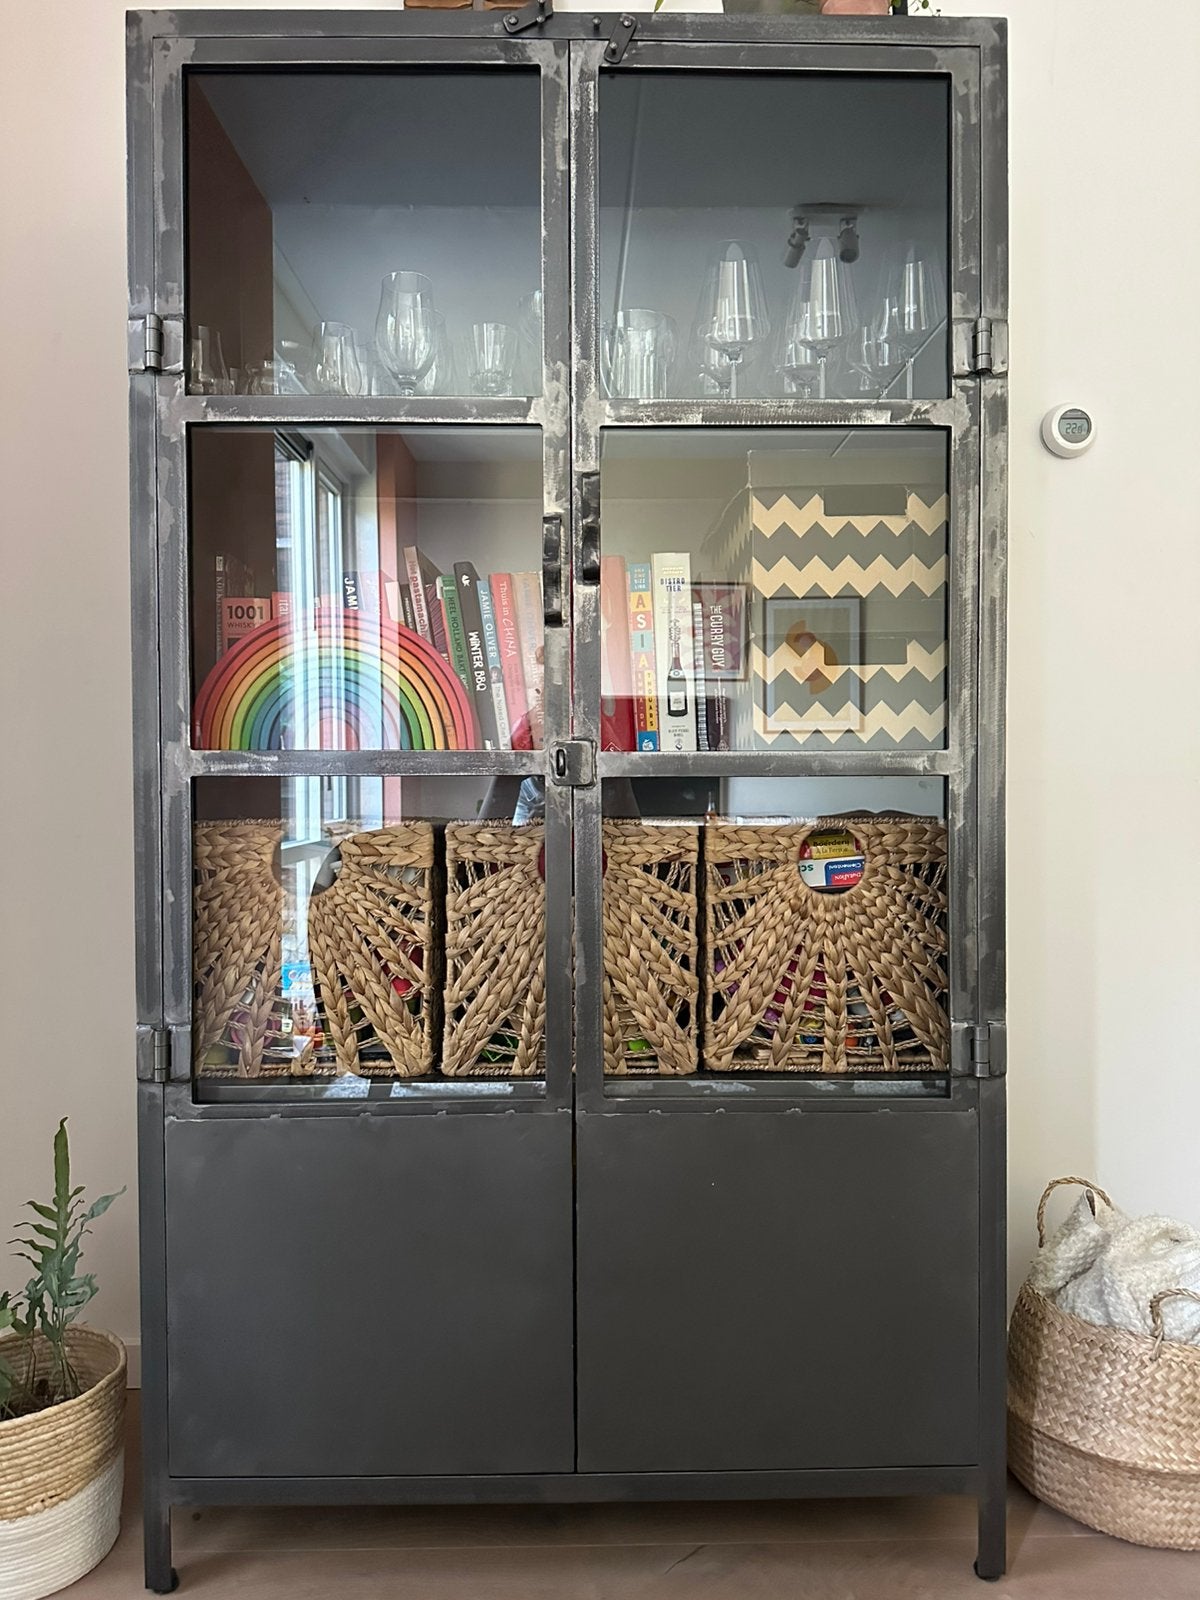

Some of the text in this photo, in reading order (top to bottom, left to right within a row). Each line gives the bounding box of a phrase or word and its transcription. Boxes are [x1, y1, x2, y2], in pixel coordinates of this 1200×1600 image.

[500, 581, 508, 605] Thuis
[227, 605, 264, 620] 1001
[503, 607, 511, 616] in
[710, 605, 723, 614] THE
[448, 597, 456, 614] HEEL
[452, 616, 463, 653] HOLLAND
[480, 590, 498, 658] JAMIE OLIVER
[710, 615, 724, 647] CURRY
[503, 618, 517, 658] CHINA
[468, 631, 487, 691] WINTER BBQ
[711, 648, 725, 667] GUY
[799, 864, 814, 872] SC
